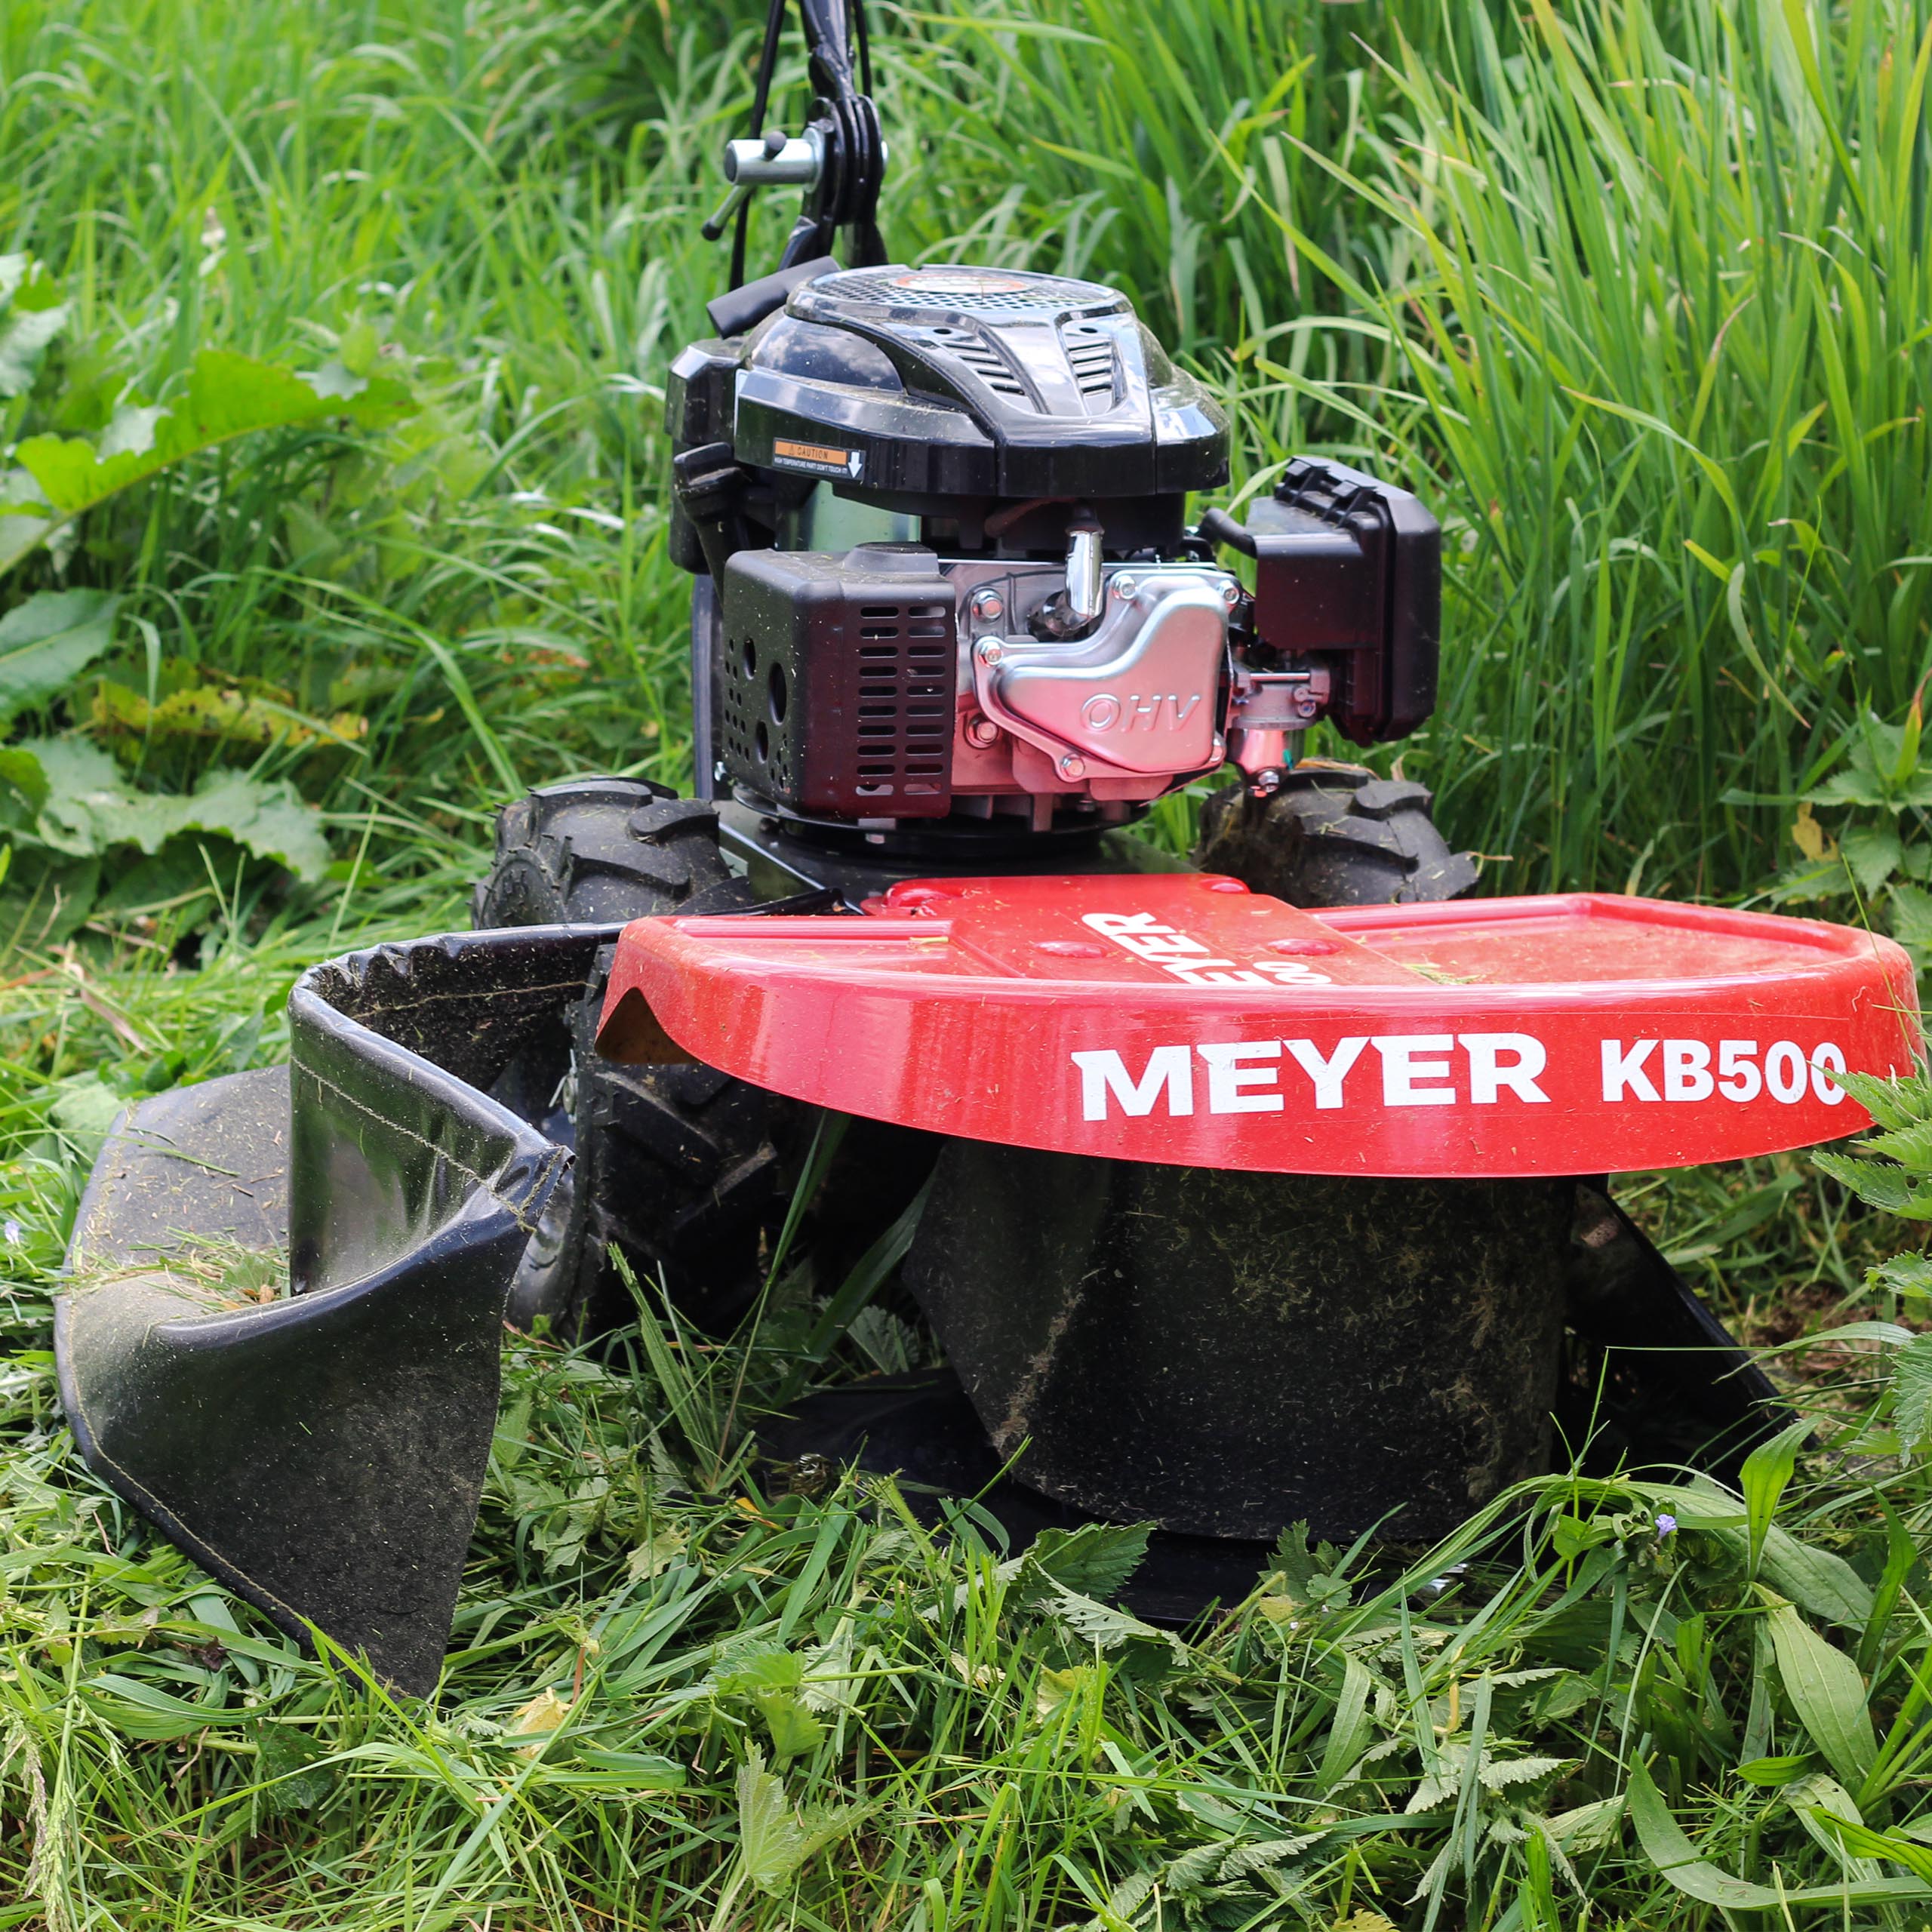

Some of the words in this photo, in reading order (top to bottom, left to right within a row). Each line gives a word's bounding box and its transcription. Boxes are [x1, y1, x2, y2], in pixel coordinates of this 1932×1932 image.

[797, 446, 829, 460] CAUTION
[1080, 693, 1201, 734] OHV
[1081, 912, 1275, 986] EYER
[1070, 1032, 1552, 1121] MEYER
[1600, 1038, 1847, 1105] KB500
